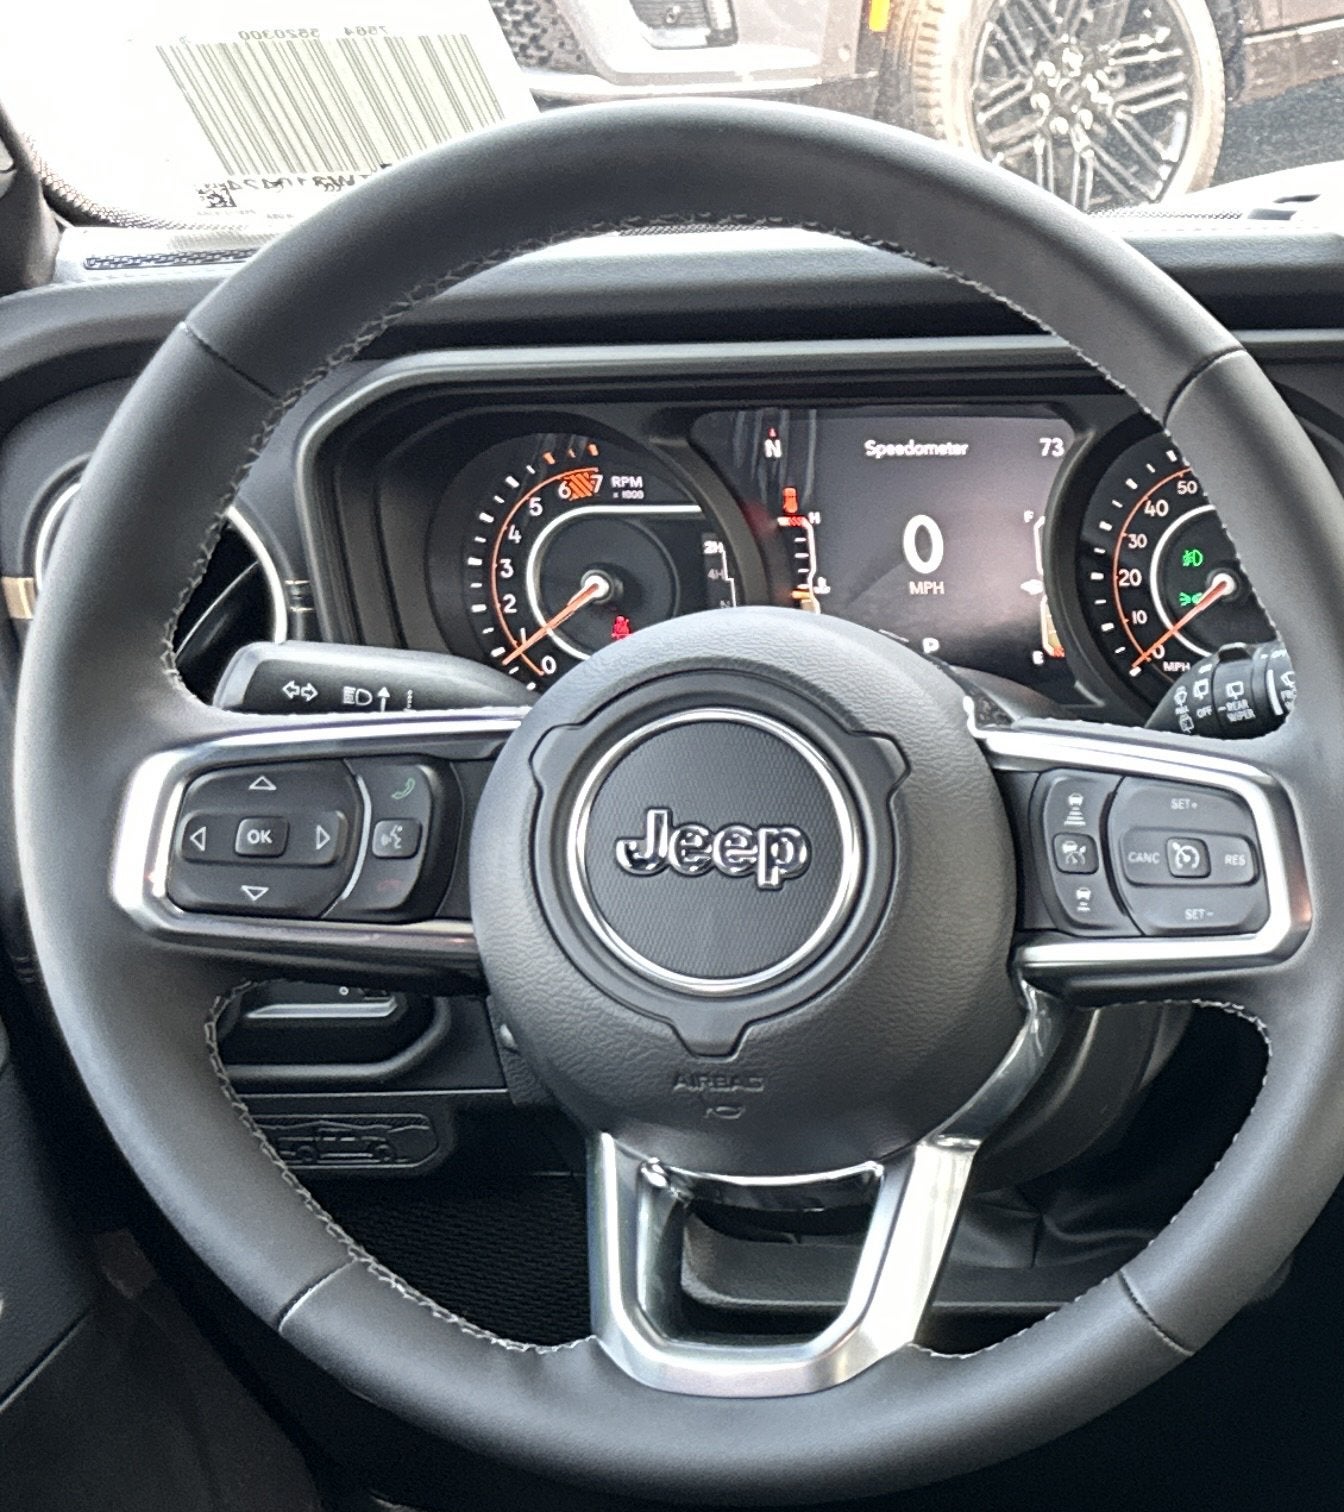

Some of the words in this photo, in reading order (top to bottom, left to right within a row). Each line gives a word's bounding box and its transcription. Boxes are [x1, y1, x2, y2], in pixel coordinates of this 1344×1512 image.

[764, 439, 783, 458] N
[864, 439, 969, 458] Speedometer
[1039, 438, 1065, 457] 73
[558, 481, 570, 500] 6
[590, 474, 604, 493] 7
[611, 475, 643, 489] RPM
[1177, 481, 1198, 496] 50
[529, 497, 543, 517] 5
[1144, 500, 1169, 517] 40
[1023, 510, 1034, 523] F
[507, 525, 522, 544] 4
[1128, 534, 1148, 549] 30
[703, 541, 724, 555] 2H
[903, 514, 944, 574] 0
[500, 558, 514, 578] 3
[1118, 569, 1142, 587] 20
[909, 581, 945, 595] MPH
[503, 594, 517, 614] 2
[1132, 611, 1148, 624] 10
[1152, 644, 1165, 659] 0
[541, 655, 557, 675] 0
[1163, 661, 1191, 672] MPH
[247, 829, 273, 845] OK
[615, 807, 811, 890] Jeep
[1128, 852, 1160, 865] CANC
[1224, 854, 1246, 866] RES
